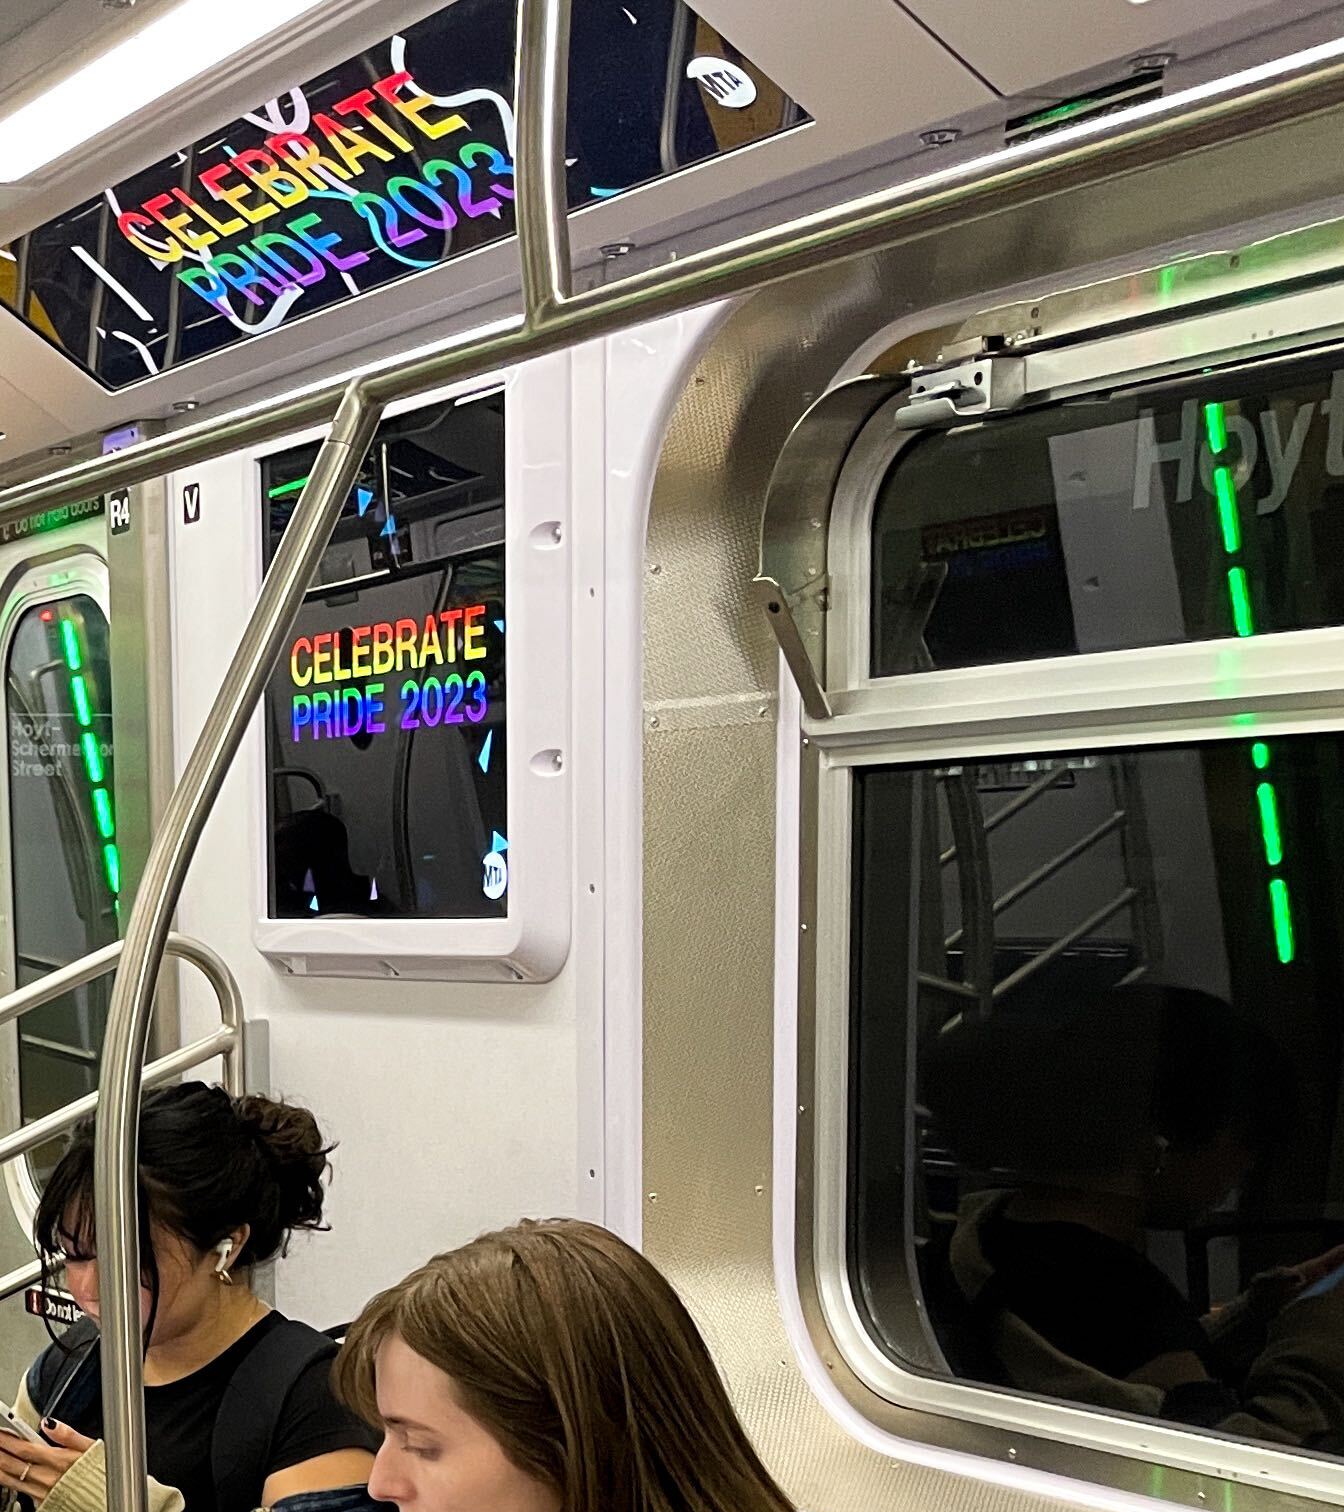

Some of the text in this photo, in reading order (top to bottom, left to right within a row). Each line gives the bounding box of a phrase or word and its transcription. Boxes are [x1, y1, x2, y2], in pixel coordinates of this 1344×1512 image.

[117, 70, 469, 262] CELEBRATE
[176, 143, 516, 317] PRIDE 2023
[110, 497, 131, 529] R4
[184, 487, 199, 519] V
[291, 605, 487, 688] CELEBRATE
[292, 670, 488, 743] PRIDE 2023
